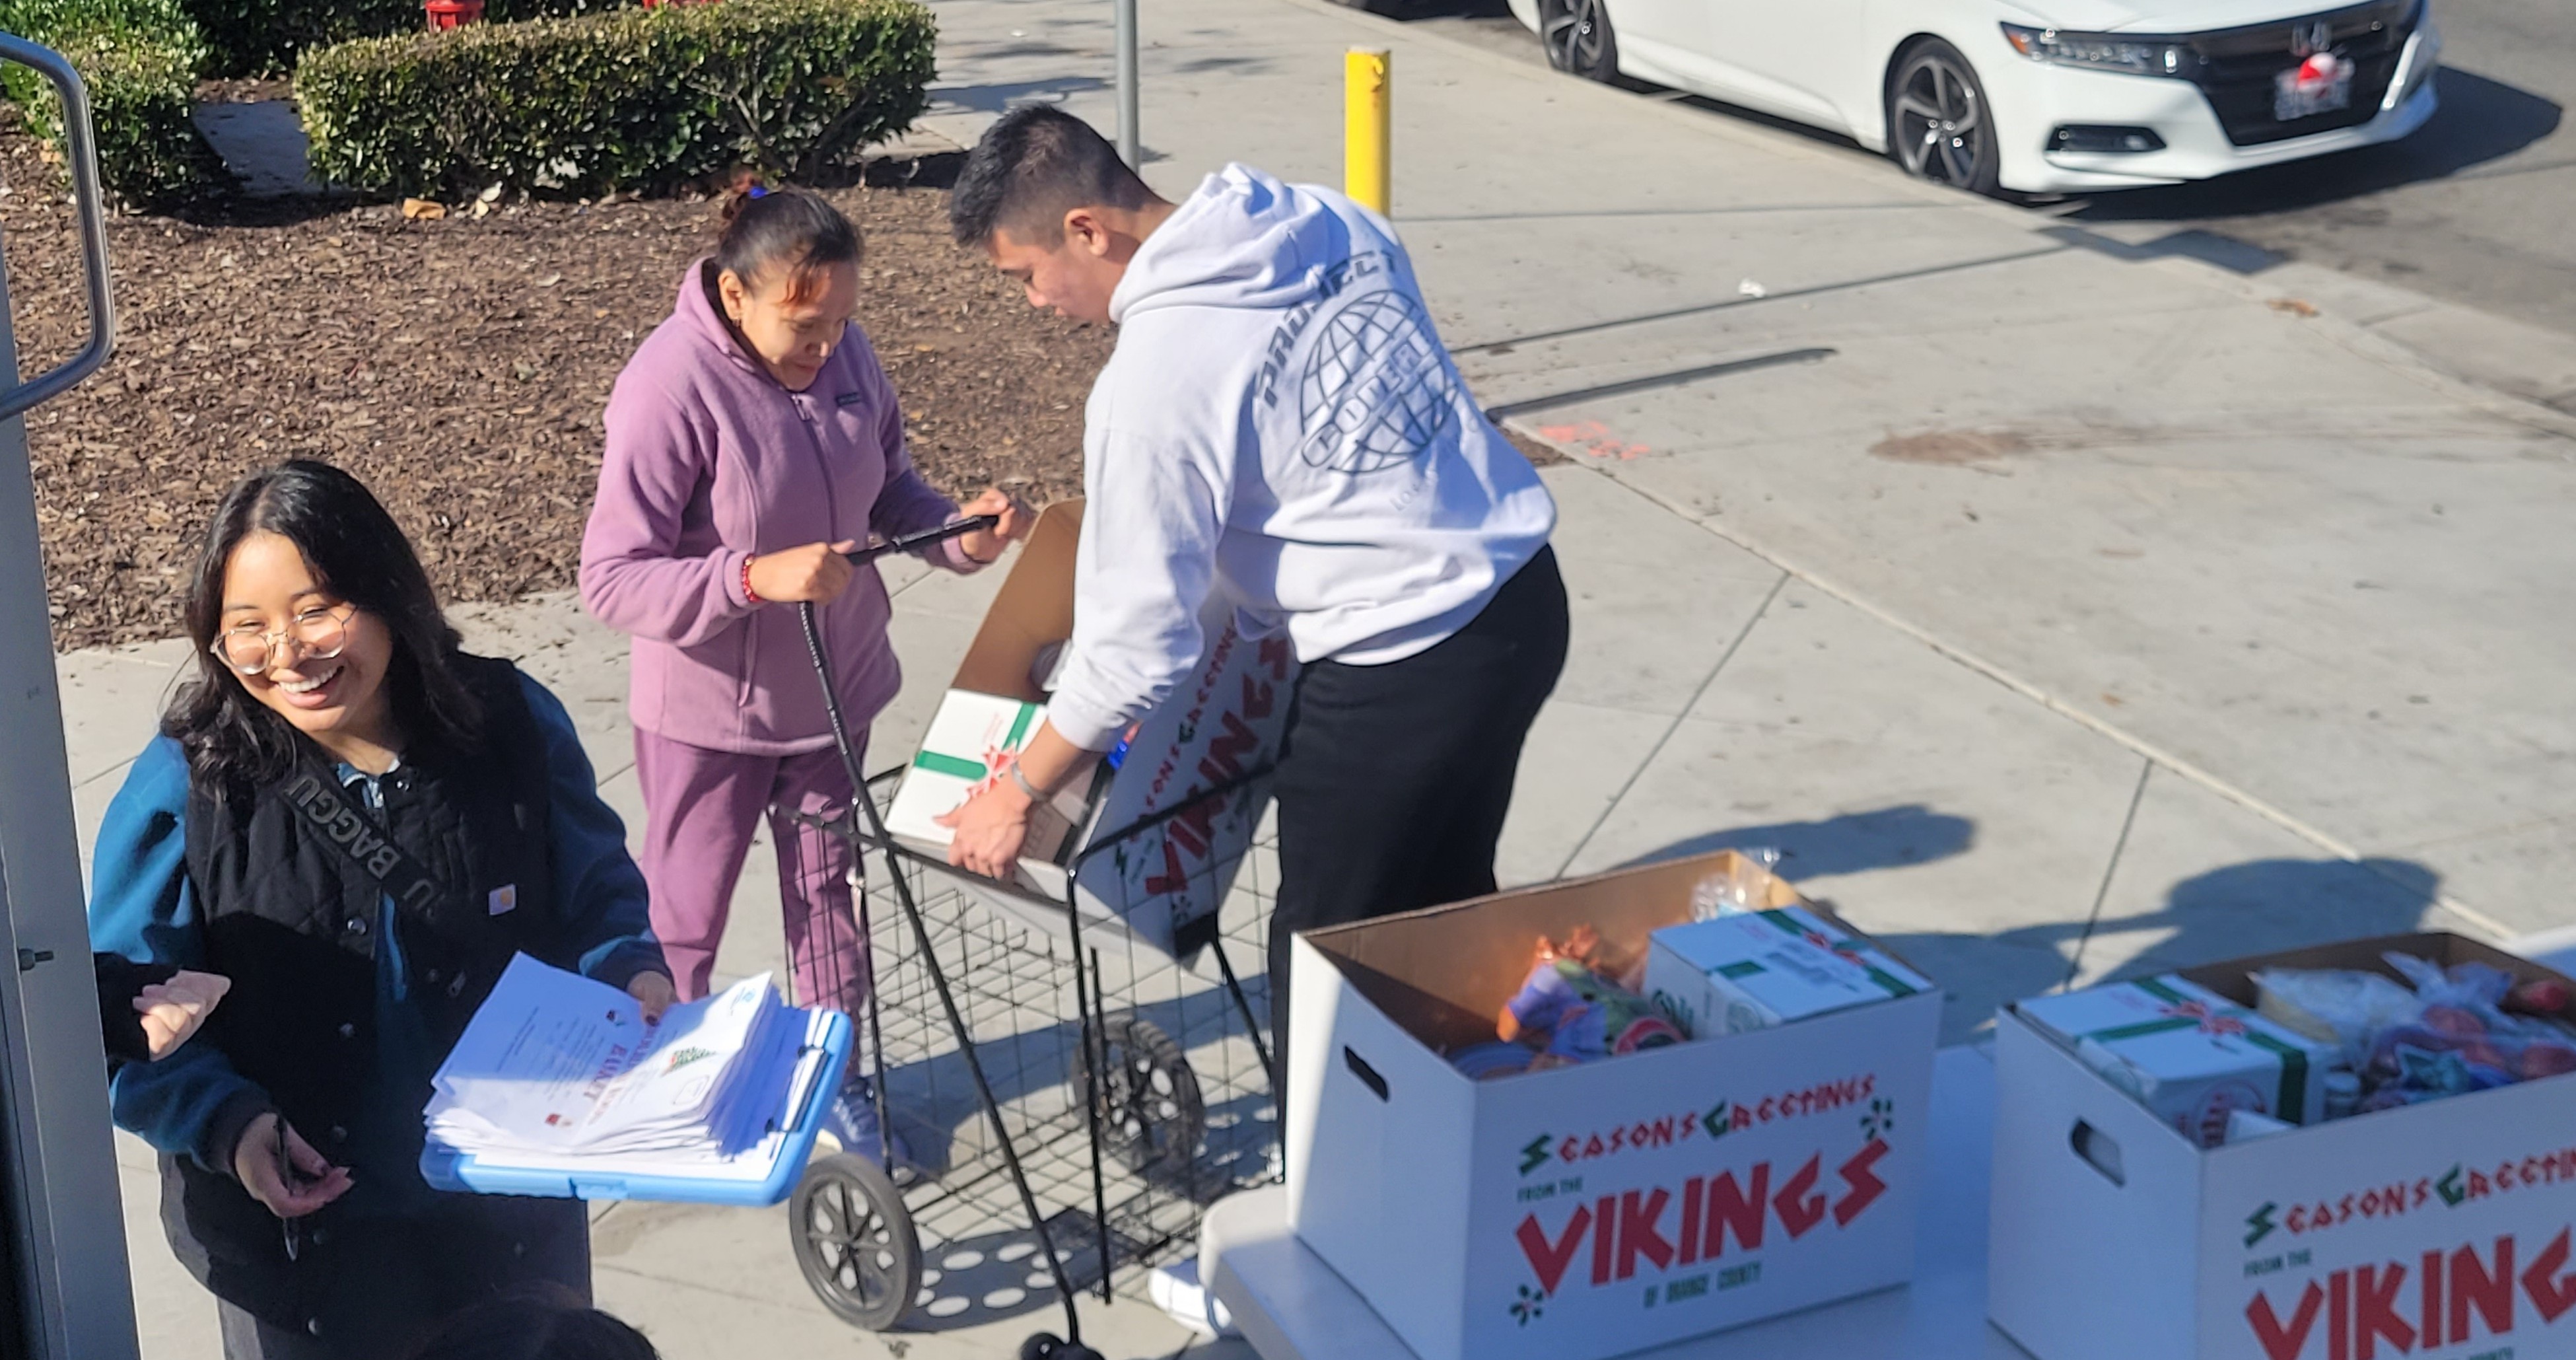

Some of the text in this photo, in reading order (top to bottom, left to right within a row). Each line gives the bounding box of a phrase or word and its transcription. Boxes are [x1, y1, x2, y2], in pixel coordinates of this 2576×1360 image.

[288, 777, 401, 879] BAGGU
[1518, 1074, 1875, 1176] SEASONS GREETINGS
[1516, 1137, 1890, 1297] VIKINGS
[2244, 1179, 2430, 1248] SEASONS
